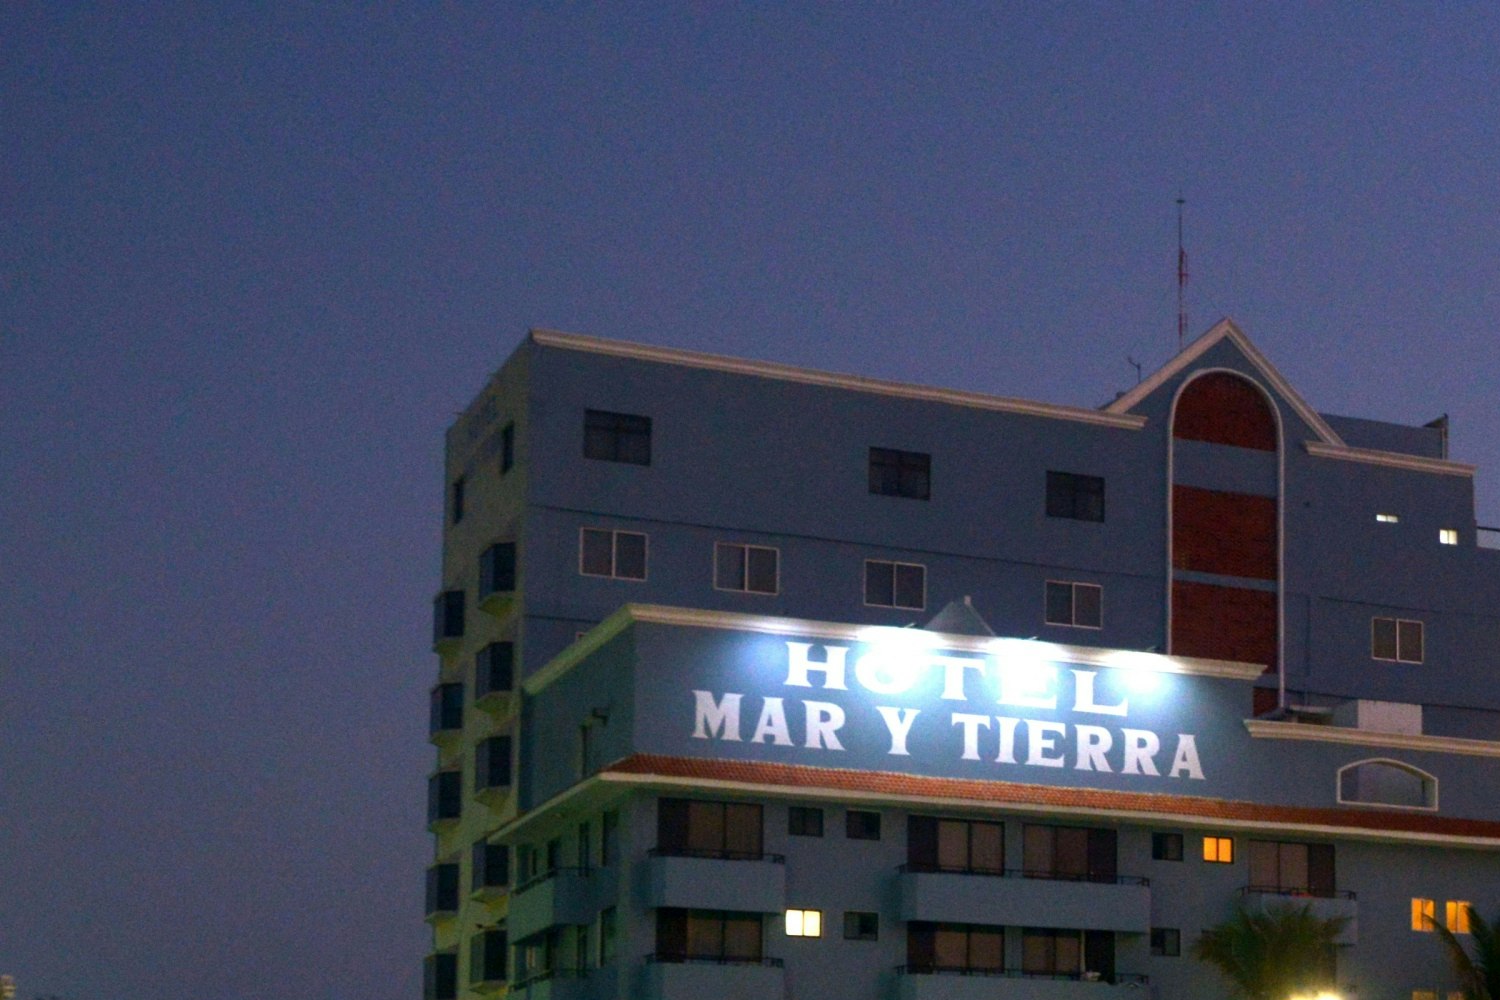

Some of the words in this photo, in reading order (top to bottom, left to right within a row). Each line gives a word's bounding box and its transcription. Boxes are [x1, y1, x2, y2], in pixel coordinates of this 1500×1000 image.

[784, 640, 1130, 717] HOTEL
[691, 689, 847, 752] MAR
[876, 706, 922, 756] Y
[951, 711, 1207, 781] TIERRA
